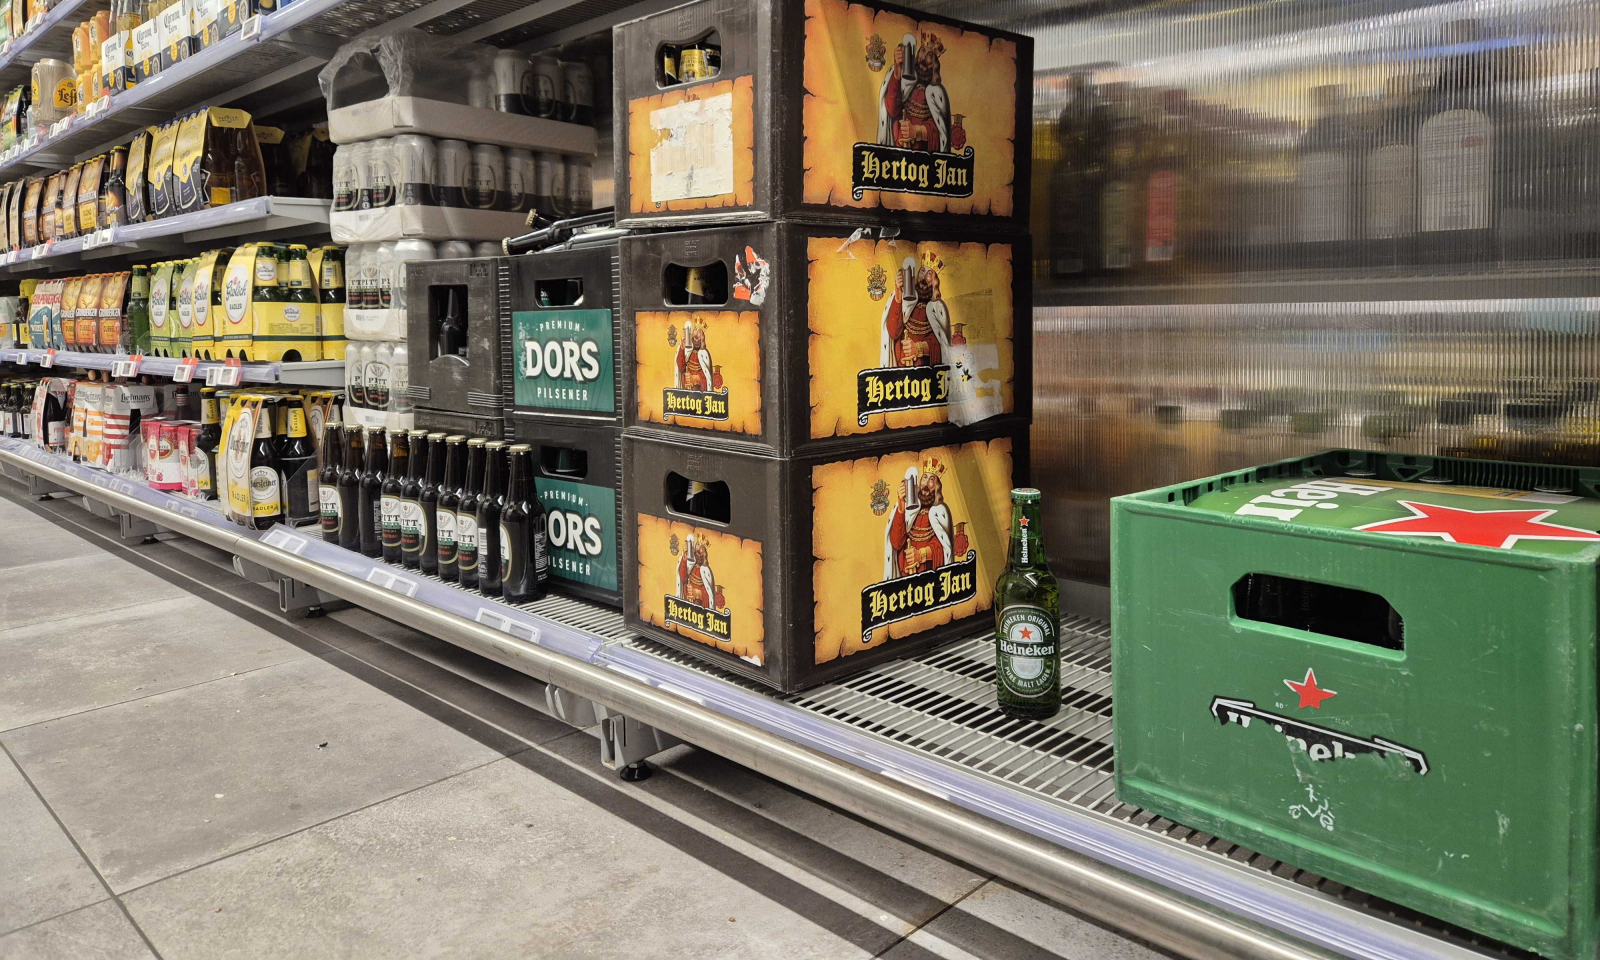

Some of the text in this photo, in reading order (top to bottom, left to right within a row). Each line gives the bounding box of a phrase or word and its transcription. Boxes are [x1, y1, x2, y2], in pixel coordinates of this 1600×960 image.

[164, 11, 180, 28] Corona
[137, 28, 152, 44] Corona
[58, 87, 77, 107] Leff
[861, 150, 969, 188] Hertog Jan
[225, 279, 248, 302] Grolsch
[229, 303, 243, 311] RADLER
[540, 320, 580, 332] PREMIUM
[525, 340, 600, 381] DORS
[537, 388, 588, 401] PILSENER
[865, 374, 932, 407] Hertog
[666, 391, 726, 416] Hertog Jan
[544, 490, 584, 507] PREMIUM
[548, 510, 602, 556] ORS
[1020, 528, 1029, 564] Heineken
[548, 555, 591, 576] ILSENER
[869, 571, 972, 621] Hertog Jan
[668, 599, 729, 636] Hertog Jan
[1003, 614, 1026, 634] HEINEKEN
[1027, 615, 1051, 637] ORIGINAL
[1000, 640, 1055, 656] Heineken
[1005, 666, 1017, 682] PURE
[1017, 679, 1034, 688] MALT
[1036, 668, 1051, 686] LAGER
